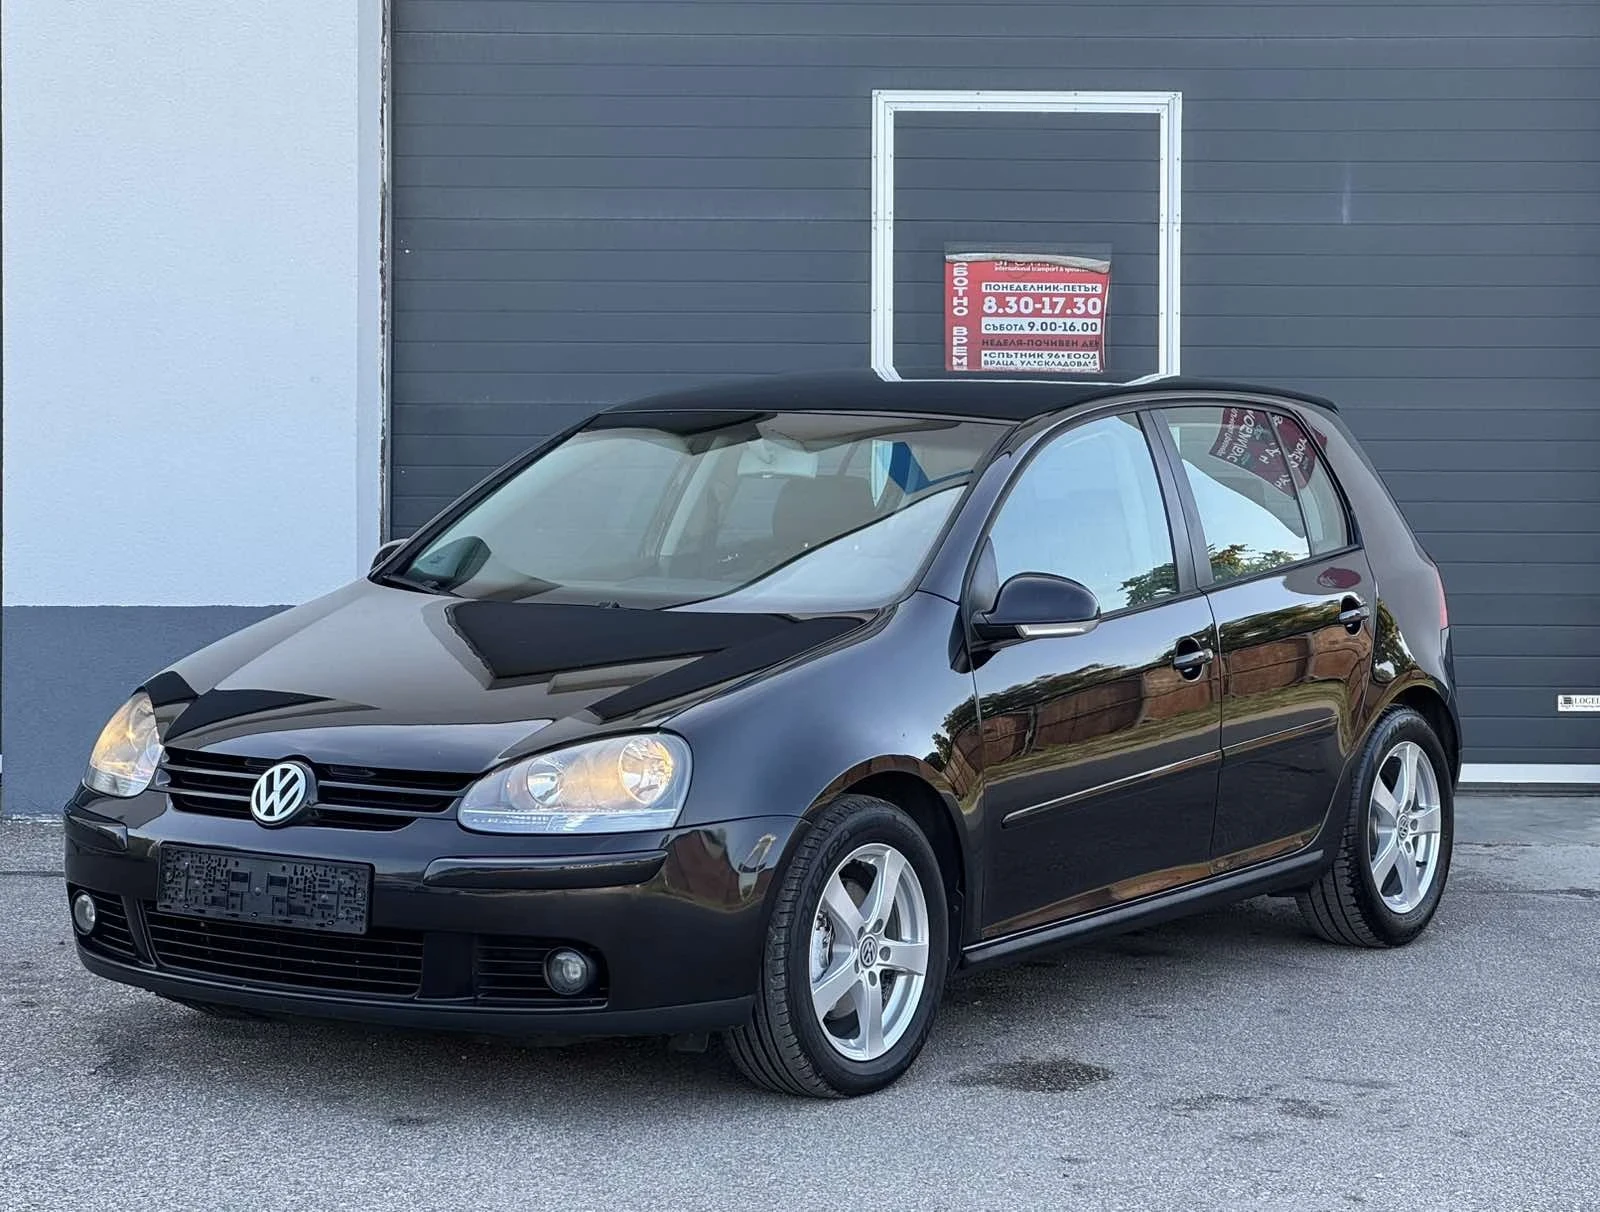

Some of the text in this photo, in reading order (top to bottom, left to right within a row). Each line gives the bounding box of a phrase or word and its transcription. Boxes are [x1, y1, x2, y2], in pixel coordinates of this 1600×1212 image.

[984, 283, 1098, 293] ПОНЕДЕЛНИК-ПЕТЪК
[983, 296, 1102, 315] 8.30-17.30
[984, 321, 1098, 332] СЪБОТА 9.00-16.00
